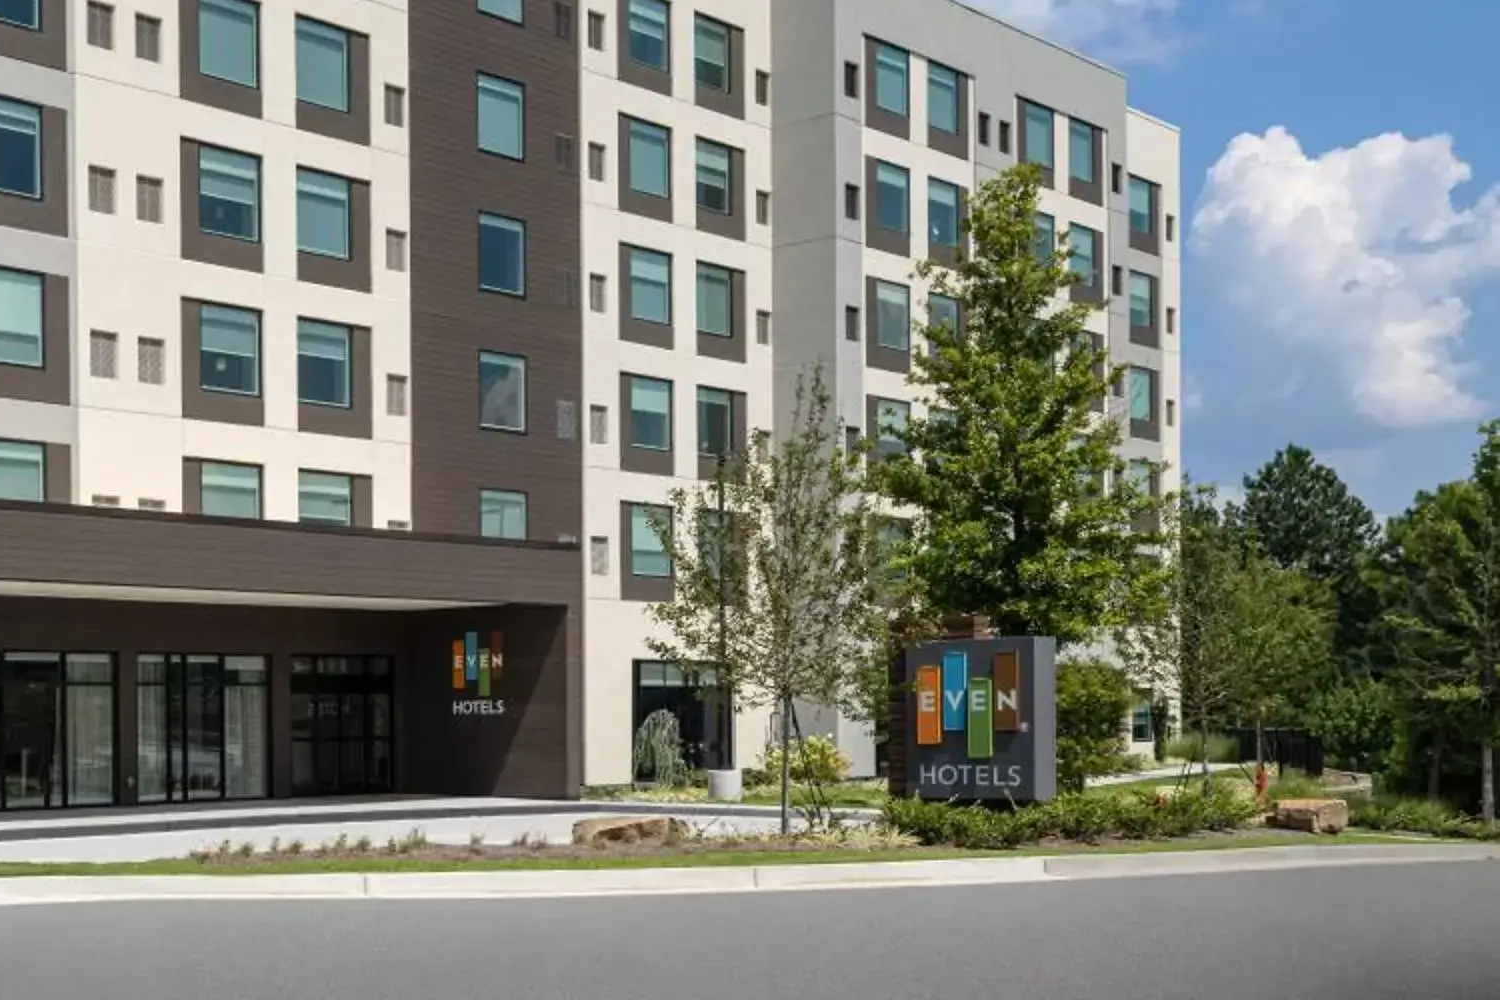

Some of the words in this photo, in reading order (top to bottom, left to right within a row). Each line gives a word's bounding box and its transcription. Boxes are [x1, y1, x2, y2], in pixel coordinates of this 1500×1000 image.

[453, 653, 503, 668] EVEN
[452, 700, 505, 715] HOTELS
[920, 690, 1017, 712] EVEN
[919, 764, 1021, 786] HOTELS
